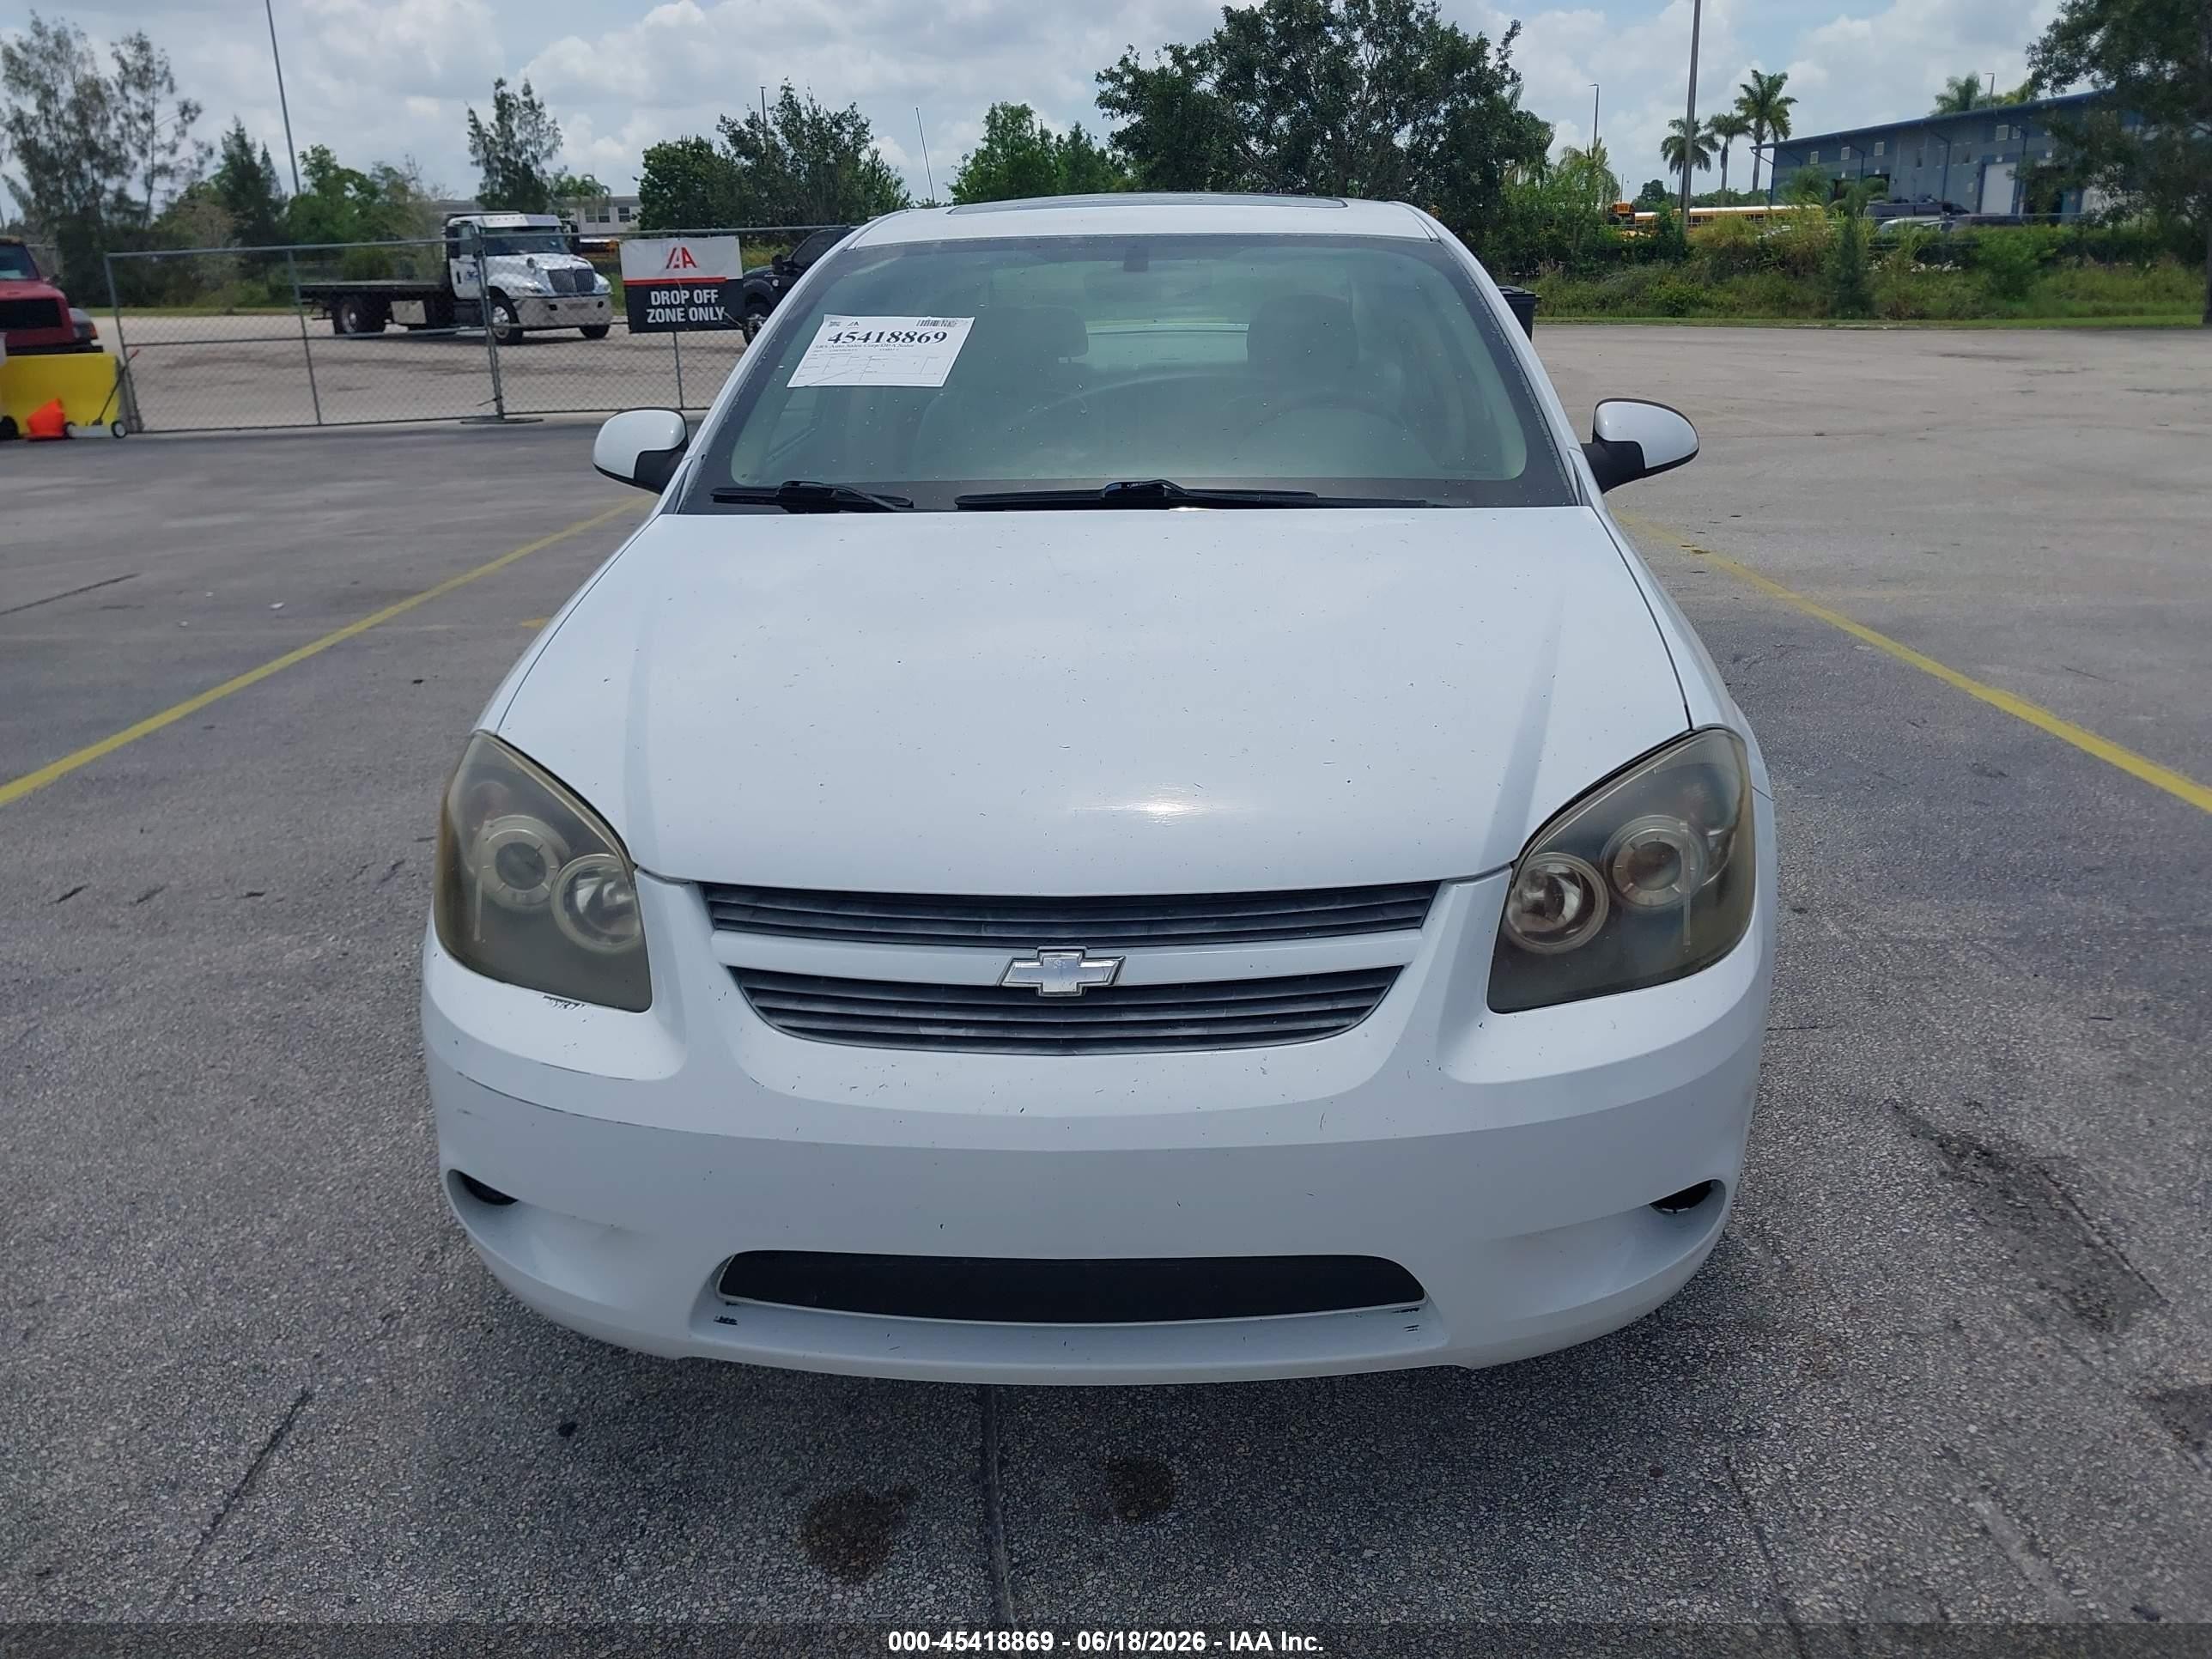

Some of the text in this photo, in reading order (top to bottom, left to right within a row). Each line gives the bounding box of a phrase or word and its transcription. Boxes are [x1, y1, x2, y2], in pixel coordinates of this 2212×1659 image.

[650, 289, 719, 306] DROP OFF
[646, 307, 726, 324] ZONE ONLY
[827, 331, 947, 344] 45418869
